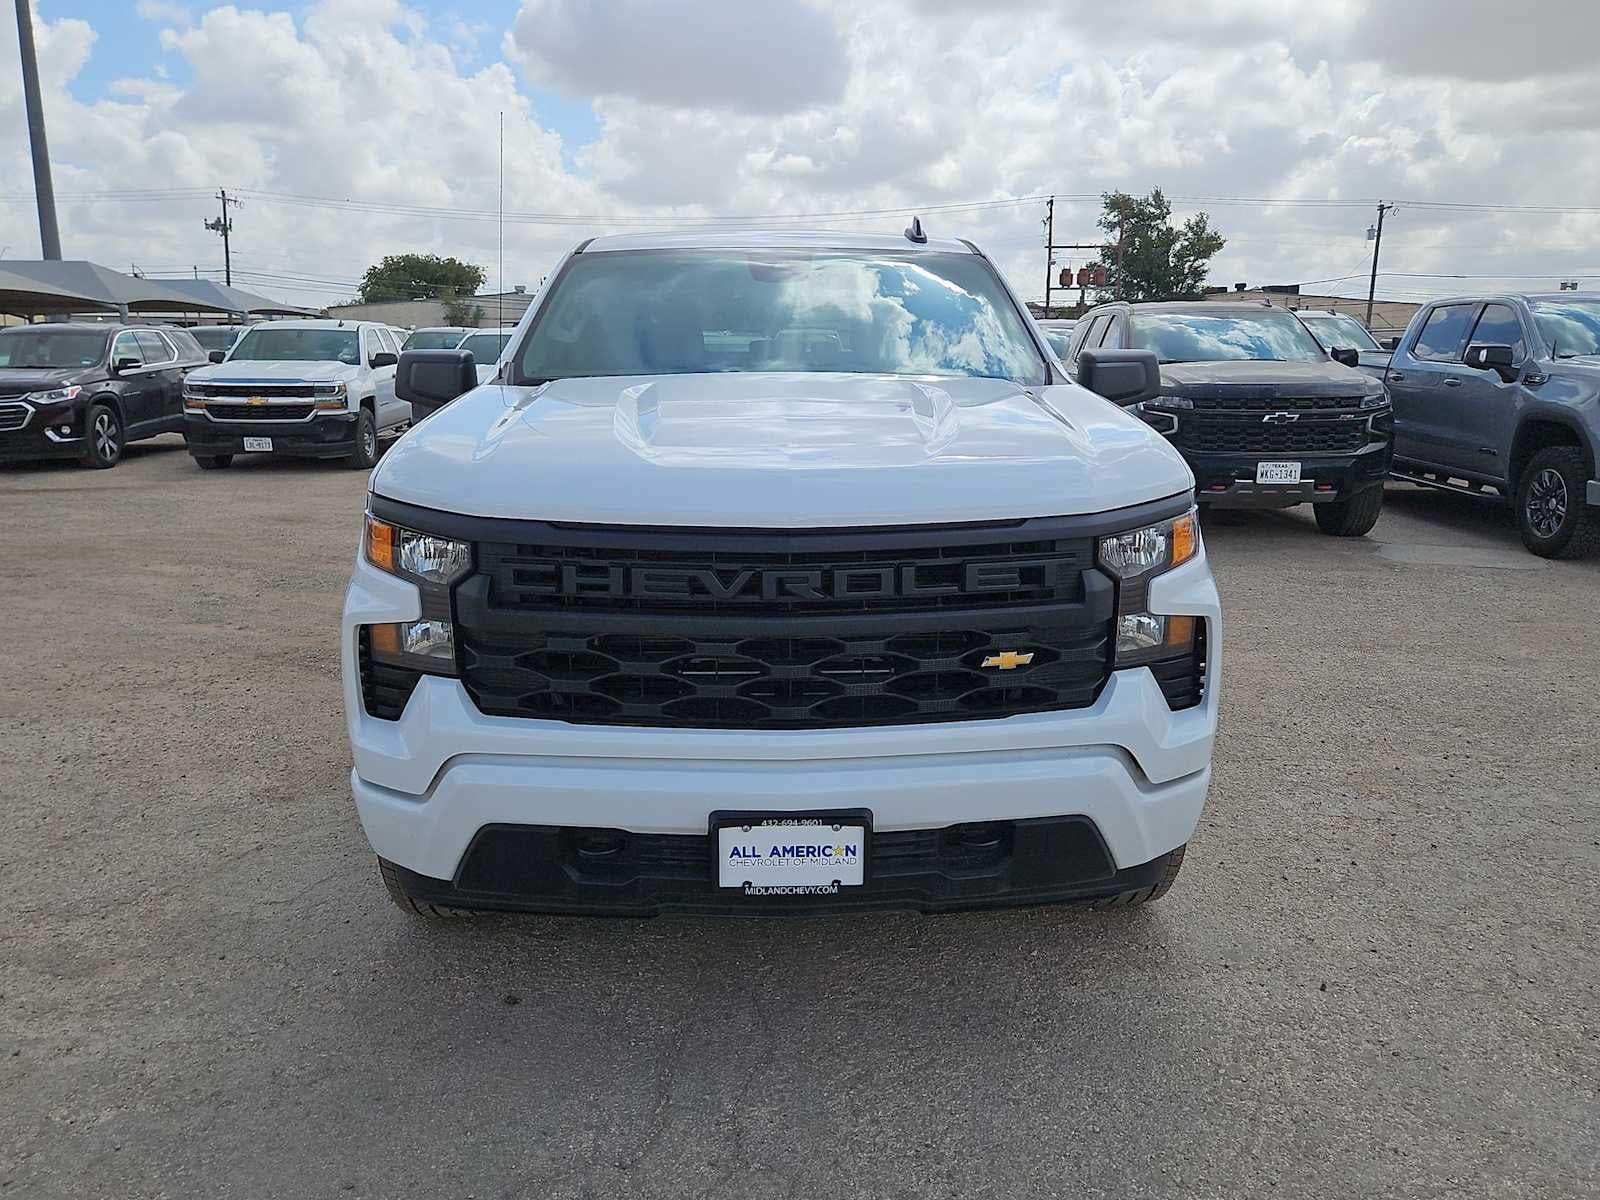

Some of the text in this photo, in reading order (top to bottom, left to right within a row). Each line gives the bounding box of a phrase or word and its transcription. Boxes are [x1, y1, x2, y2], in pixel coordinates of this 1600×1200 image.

[1260, 470, 1297, 479] WKG-1341
[500, 555, 1076, 600] CHEVROLET
[761, 819, 823, 827] 432-694-9601
[729, 846, 761, 858] ALL
[729, 857, 857, 867] CHEVROLET OF MIDLAND
[744, 886, 838, 895] MIDLANDCHEVY.COM
